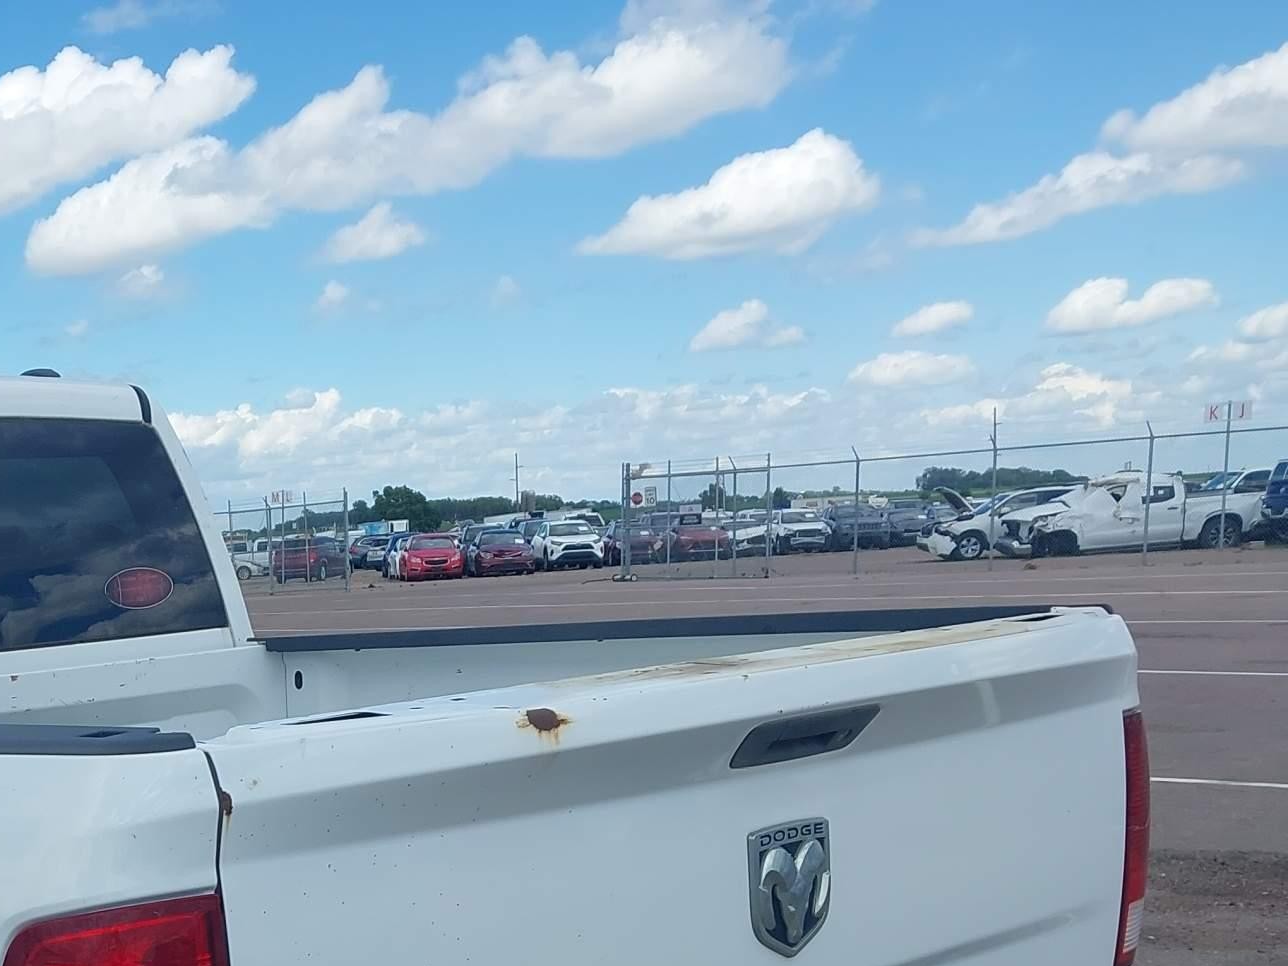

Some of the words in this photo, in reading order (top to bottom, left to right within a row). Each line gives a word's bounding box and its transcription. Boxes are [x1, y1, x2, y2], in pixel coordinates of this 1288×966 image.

[1209, 404, 1218, 420] K
[1239, 402, 1245, 418] J
[760, 822, 825, 847] DODGE
